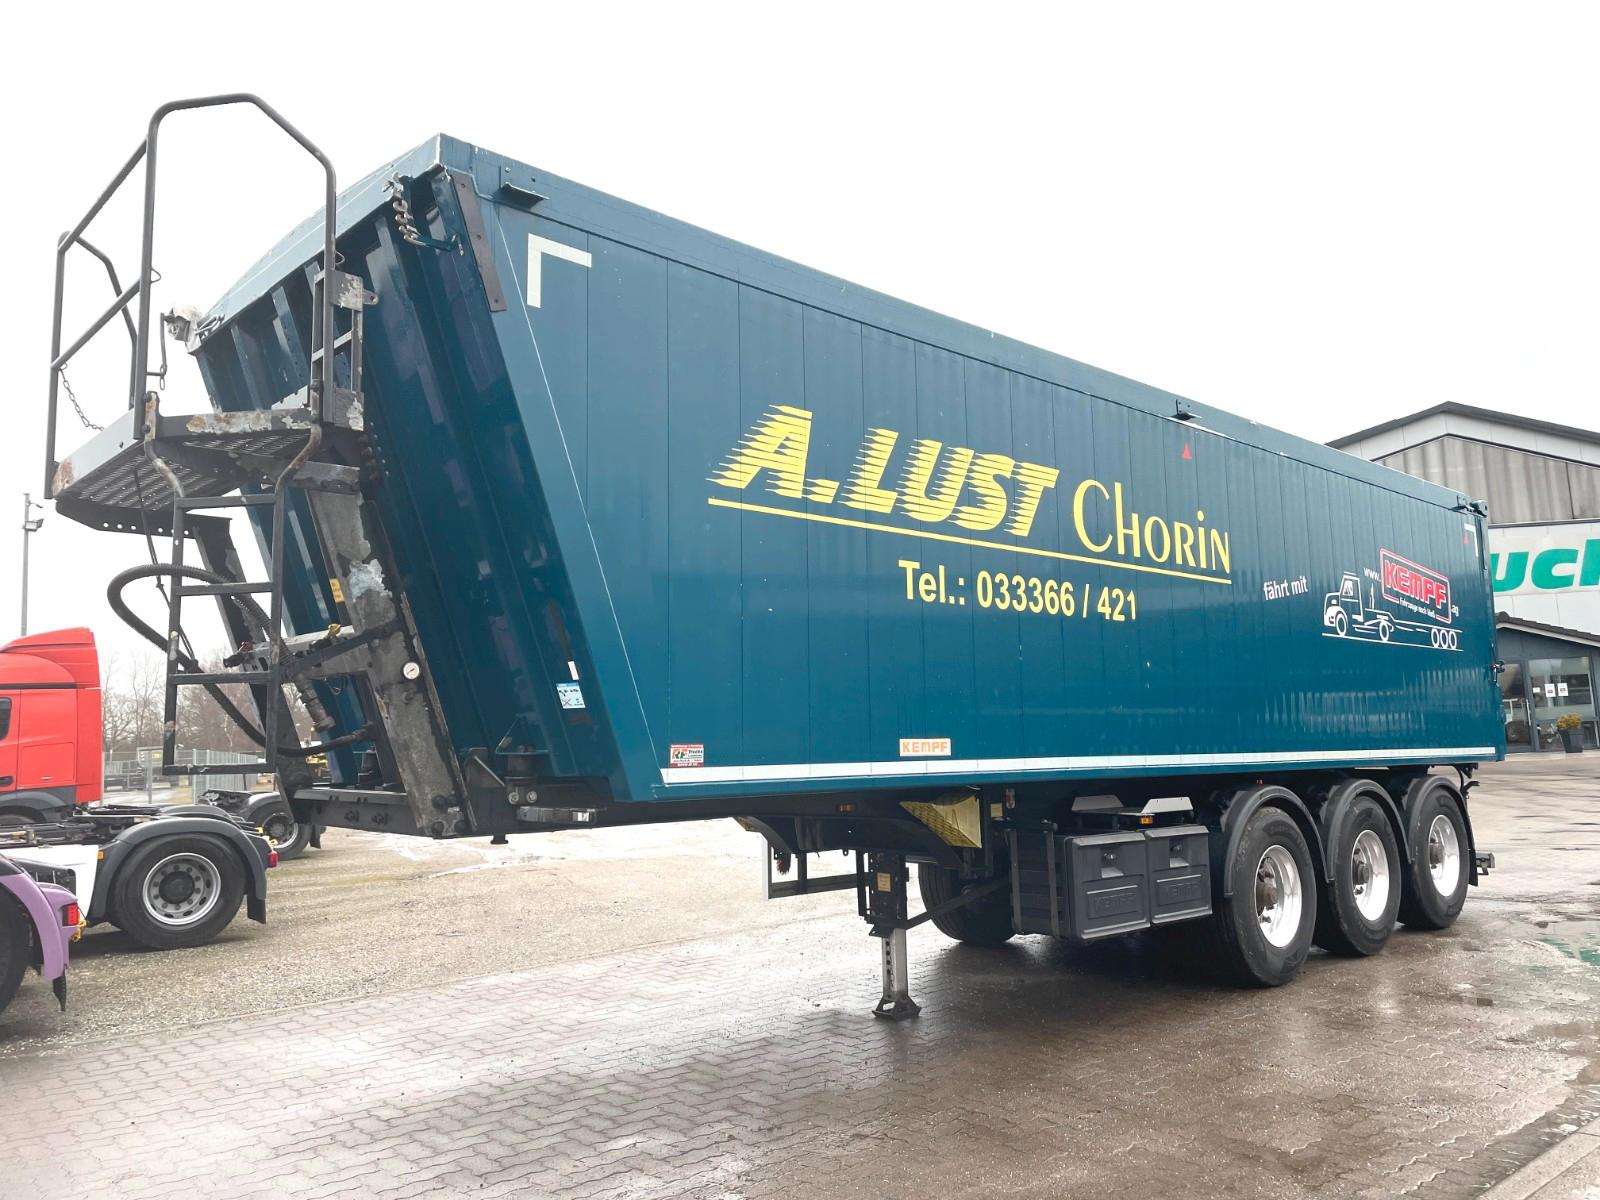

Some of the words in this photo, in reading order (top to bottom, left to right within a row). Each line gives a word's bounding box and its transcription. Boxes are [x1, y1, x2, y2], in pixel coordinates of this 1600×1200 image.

[898, 559, 966, 606] Tel.:
[976, 570, 1076, 617] 033366
[1097, 586, 1137, 622] 421
[1263, 579, 1290, 601] fährt
[1291, 575, 1309, 596] mit
[1384, 559, 1447, 609] KEMPF
[902, 741, 948, 753] KEMPF
